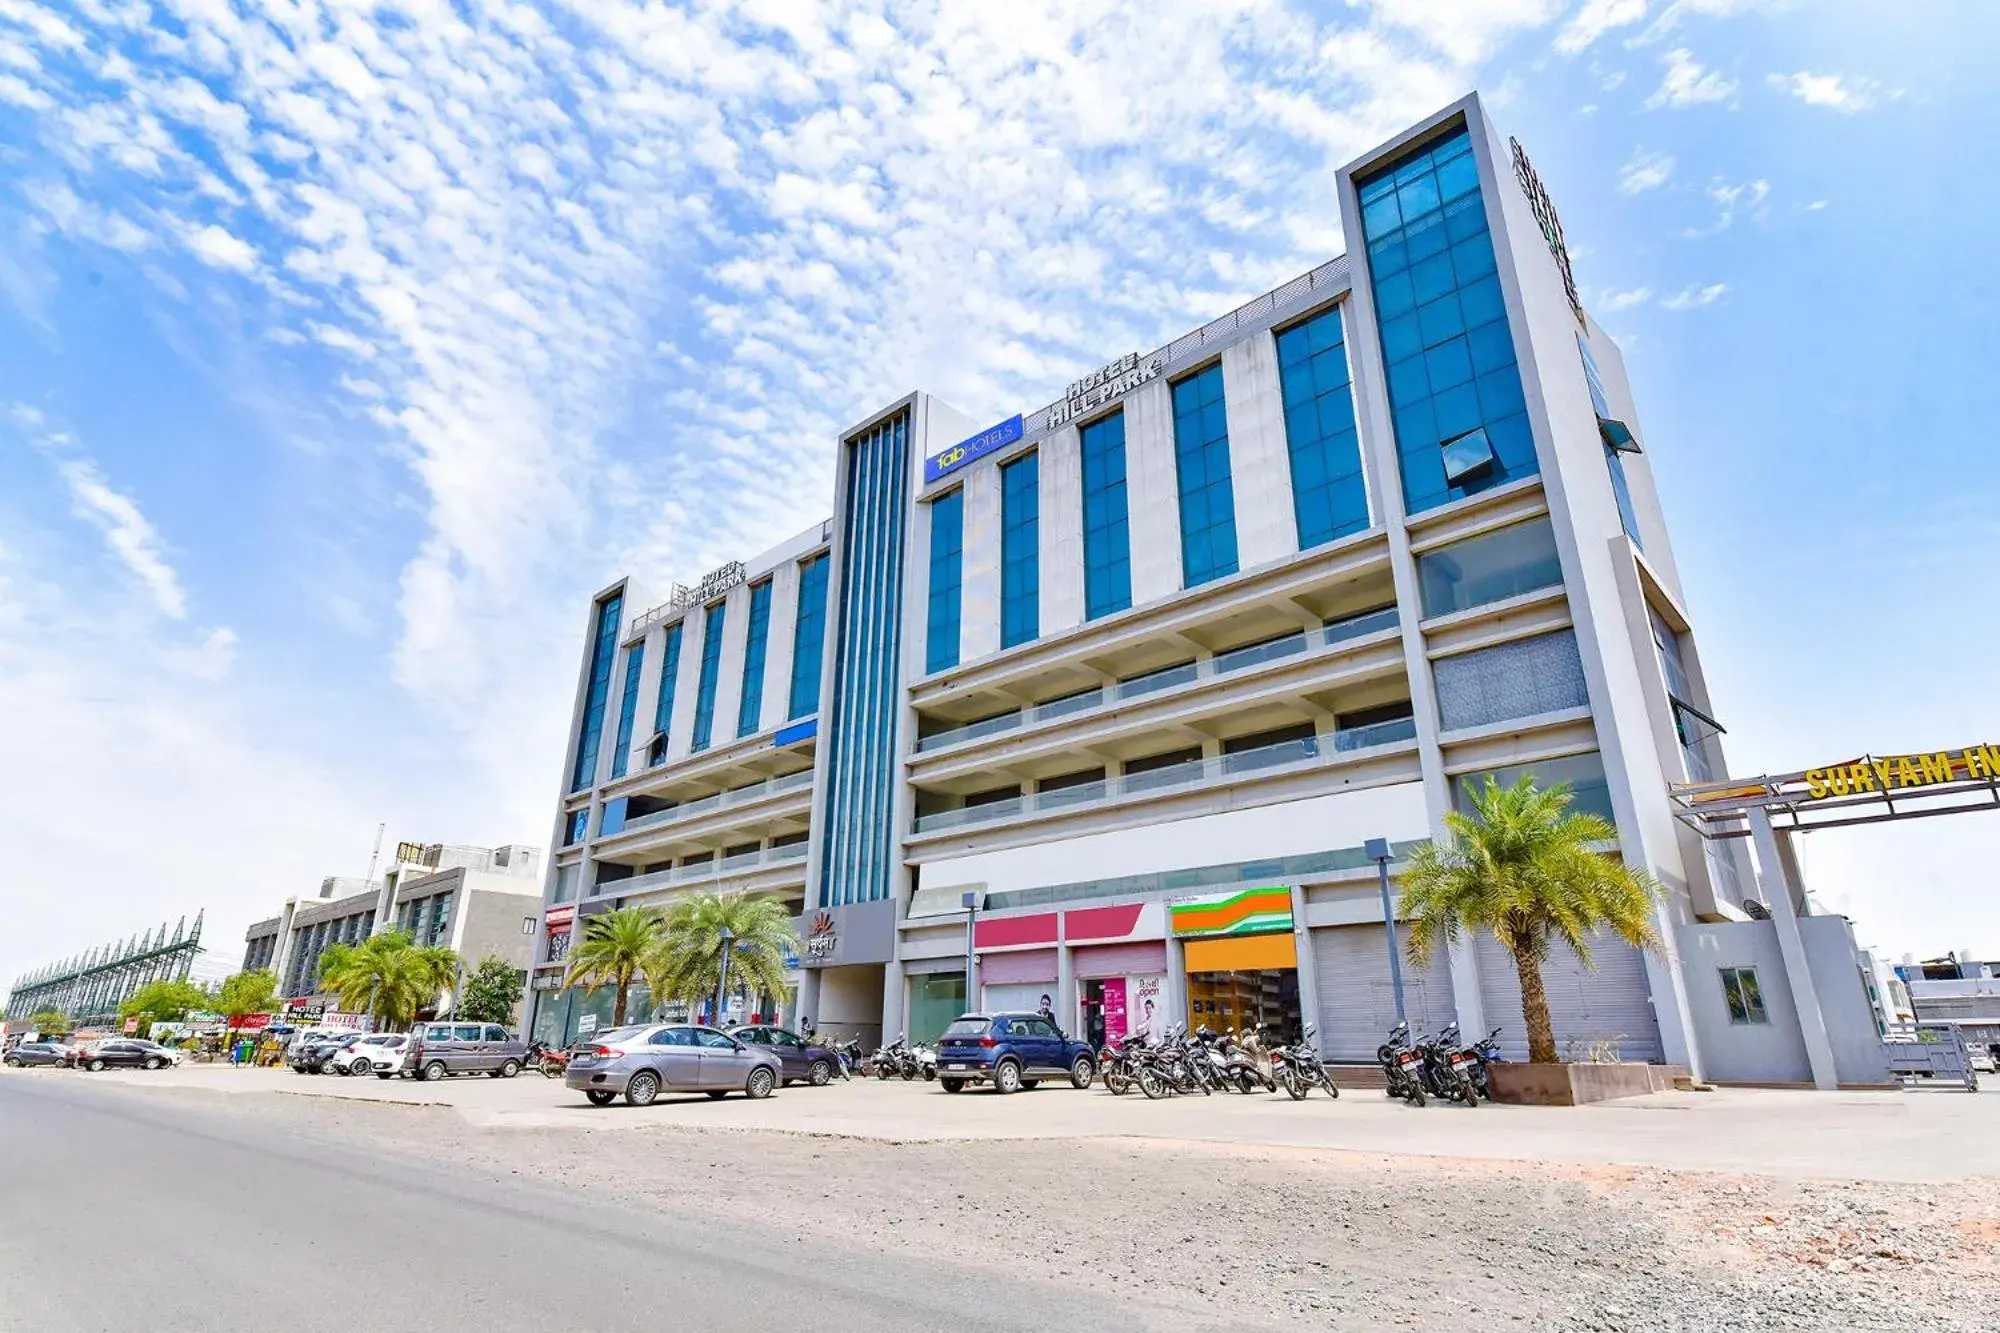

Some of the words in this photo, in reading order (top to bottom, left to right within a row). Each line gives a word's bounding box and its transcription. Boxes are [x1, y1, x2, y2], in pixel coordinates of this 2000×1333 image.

[1047, 392, 1096, 430] HILL
[1099, 360, 1162, 403] PARK
[1066, 352, 1141, 400] HOTEL
[1806, 751, 1954, 800] SURYAM
[1139, 988, 1159, 997] open
